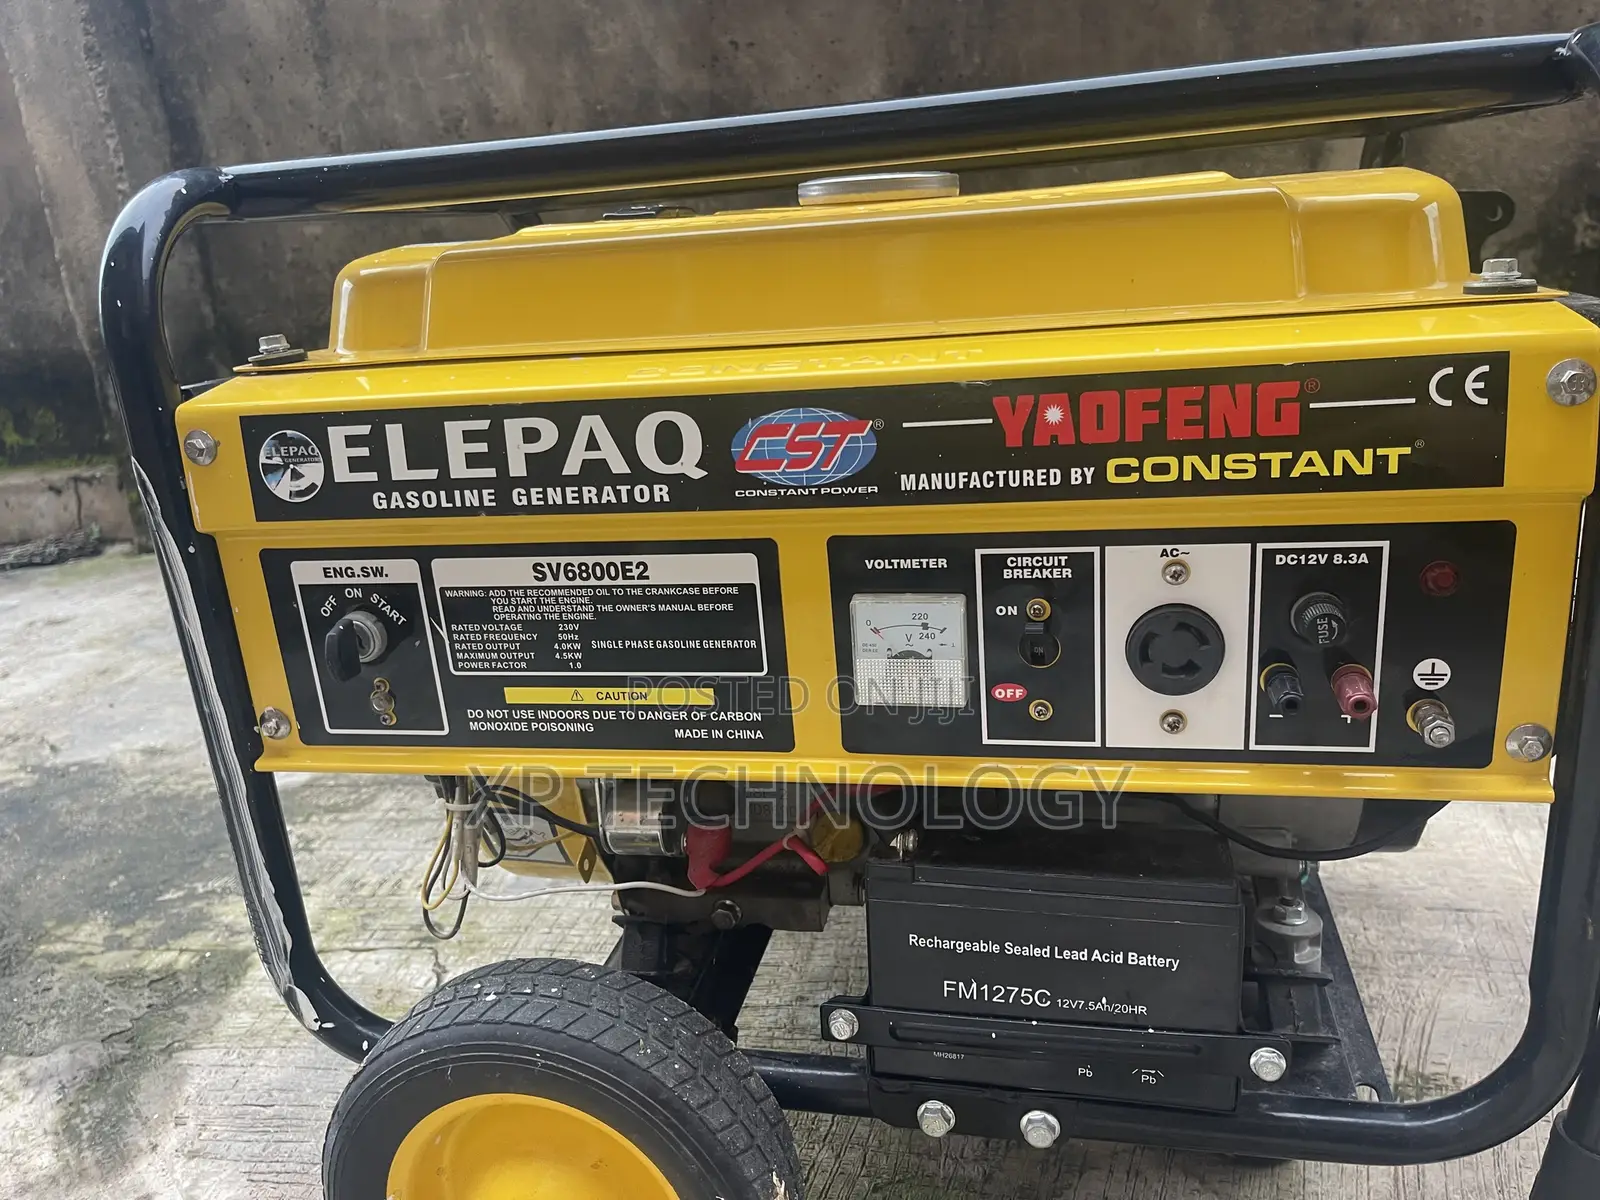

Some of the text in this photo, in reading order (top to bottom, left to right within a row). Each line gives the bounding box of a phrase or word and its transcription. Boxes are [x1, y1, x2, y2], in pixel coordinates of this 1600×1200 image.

[1428, 364, 1490, 407] CE
[993, 380, 1300, 447] YAOFENG
[263, 445, 320, 456] ELEPAQ
[326, 409, 708, 484] ELEPAQ
[735, 419, 873, 474] CST
[1105, 446, 1411, 485] CONSTANT
[900, 466, 1095, 492] MANUFACTURED BY
[372, 483, 670, 511] GASOLINE GENERATOR
[735, 485, 879, 498] CONSTANT POWER
[864, 558, 948, 570] VOLTMETER
[1006, 556, 1068, 567] CIRCUIT
[1275, 553, 1369, 565] DC12V 8.3A
[322, 566, 389, 579] ENG.SW.
[531, 561, 650, 583] SV6800E2
[1003, 567, 1072, 579] BREAKER
[344, 588, 363, 599] ON
[527, 589, 594, 597] RECOMMENDED
[596, 588, 610, 596] OIL
[645, 587, 700, 595] CRANKCASE
[702, 587, 739, 595] BEFORE
[320, 595, 338, 618] OFF
[510, 597, 537, 605] START
[370, 593, 407, 626] START
[492, 605, 516, 613] READ
[517, 605, 535, 613] AND
[615, 604, 656, 612] OWNER'S
[995, 605, 1018, 616] ON
[493, 613, 542, 621] OPERATING
[543, 613, 561, 621] THE
[911, 612, 929, 621] 220
[918, 632, 936, 640] 240
[1317, 617, 1330, 644] FUSE
[453, 633, 482, 641] RATED
[483, 633, 538, 641] FREQUENCY
[591, 640, 757, 649] SINGLE PHASE GASOLINE GENERATOR
[456, 652, 582, 660] MAXIMUM OUTPUT 4.5KW
[596, 691, 648, 701] CAUTION
[994, 688, 1023, 699] OFF
[467, 709, 762, 722] DO NOT USE INDOORS DUE TO DANGER OF CARBON
[469, 721, 594, 733] MONOXIDE POISONING
[674, 728, 764, 740] MADE IN CHINA
[908, 934, 1180, 971] Rechargeable Sealed Lead Acid Battery
[942, 978, 1052, 1008] FM1275C
[1078, 1067, 1093, 1078] Pb
[1141, 1074, 1157, 1085] Pb
